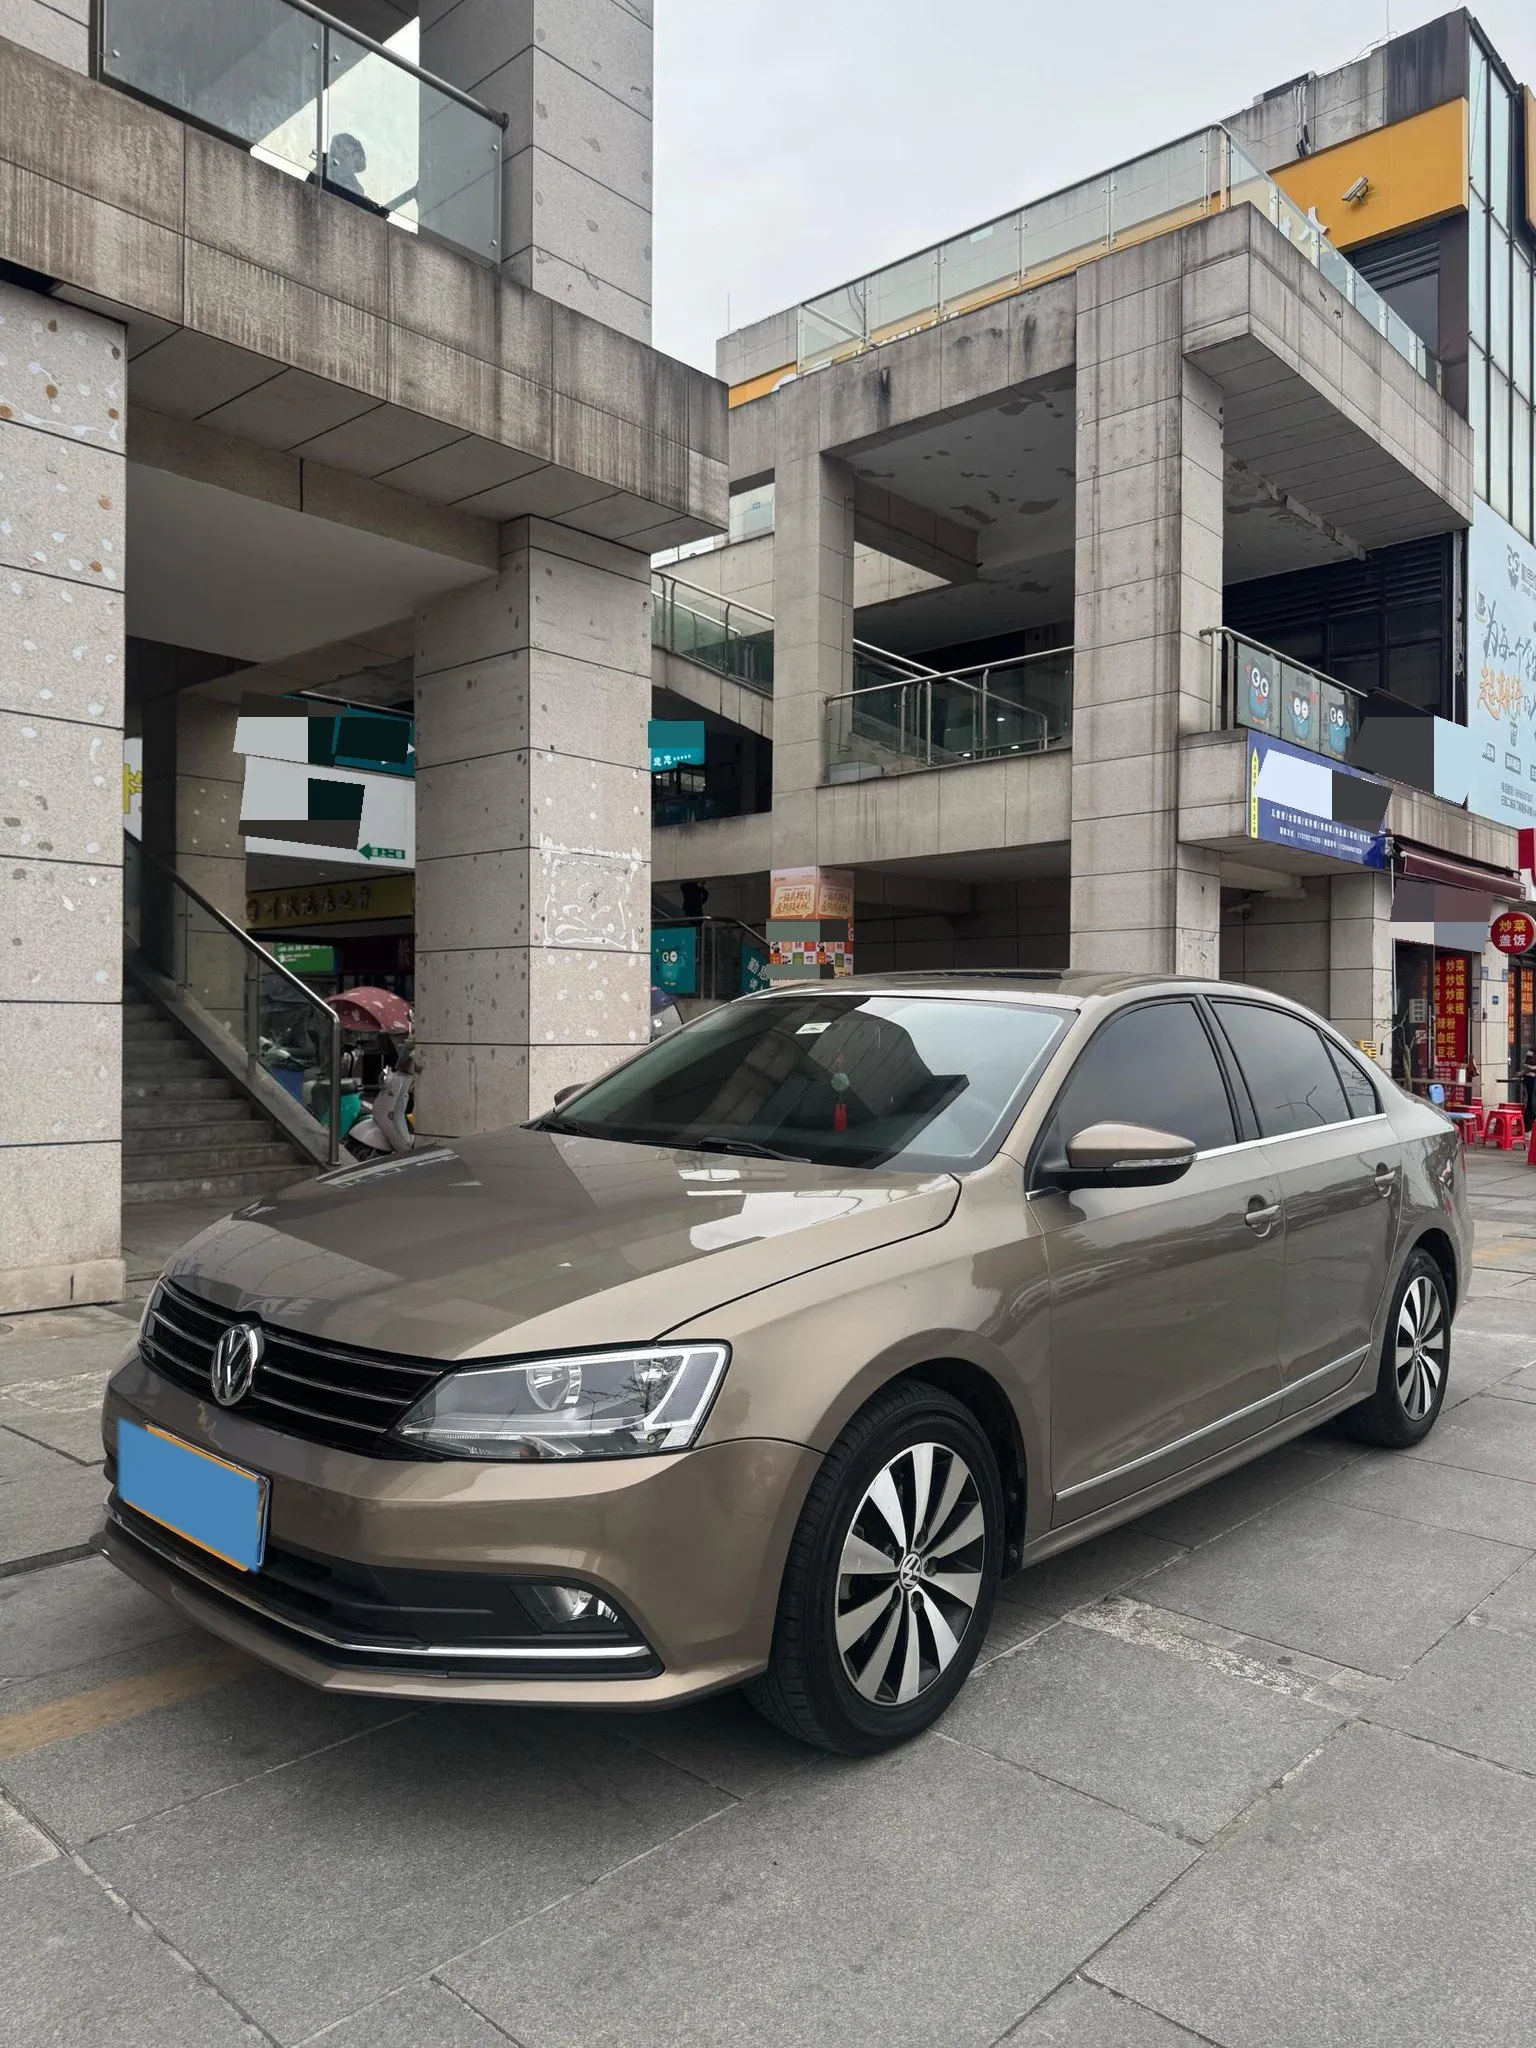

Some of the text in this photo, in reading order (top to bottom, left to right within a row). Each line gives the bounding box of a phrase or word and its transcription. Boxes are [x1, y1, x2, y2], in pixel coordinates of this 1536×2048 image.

[1499, 919, 1526, 932] 炒菜
[1499, 934, 1526, 947] 盖饭
[1445, 960, 1465, 972] 炒菜
[1445, 974, 1465, 987] 炒饭
[1445, 988, 1465, 1001] 炒面
